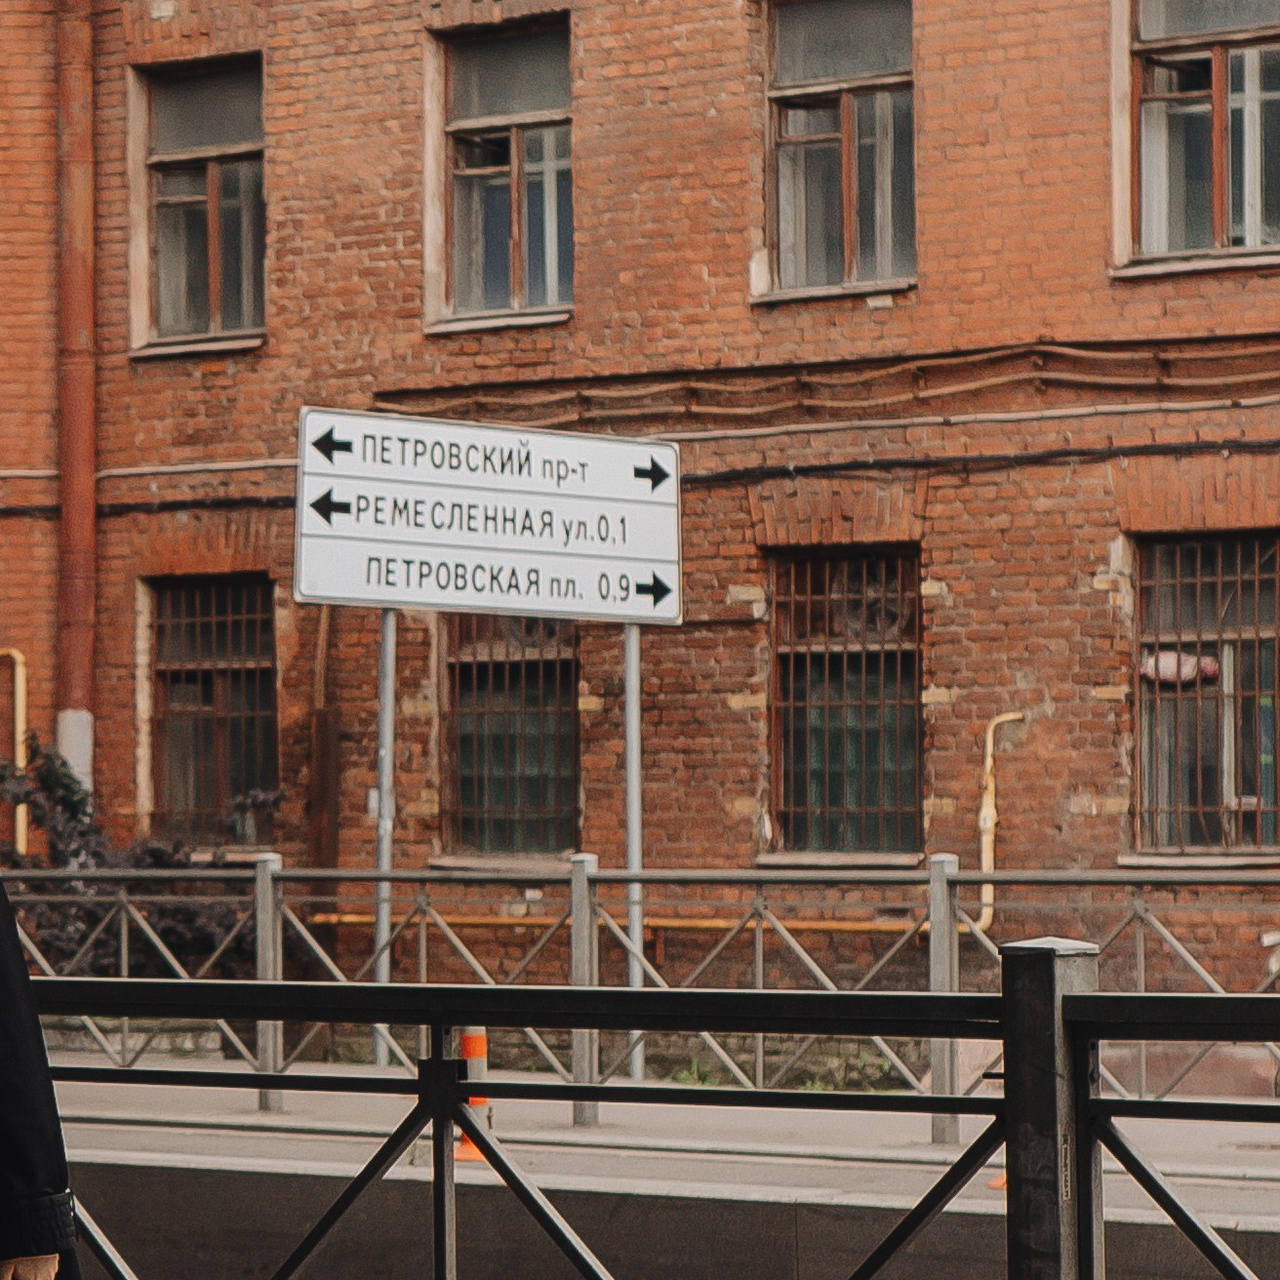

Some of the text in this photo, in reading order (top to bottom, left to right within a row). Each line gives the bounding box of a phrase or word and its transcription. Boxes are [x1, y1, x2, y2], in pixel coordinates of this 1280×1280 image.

[362, 433, 589, 488] ПЕТРОВСКИЙ пр-т
[355, 493, 554, 539] РЕМЕСЛЕННАЯ
[365, 556, 630, 603] ПЕТРОВСКАЯ пл. 0,9
